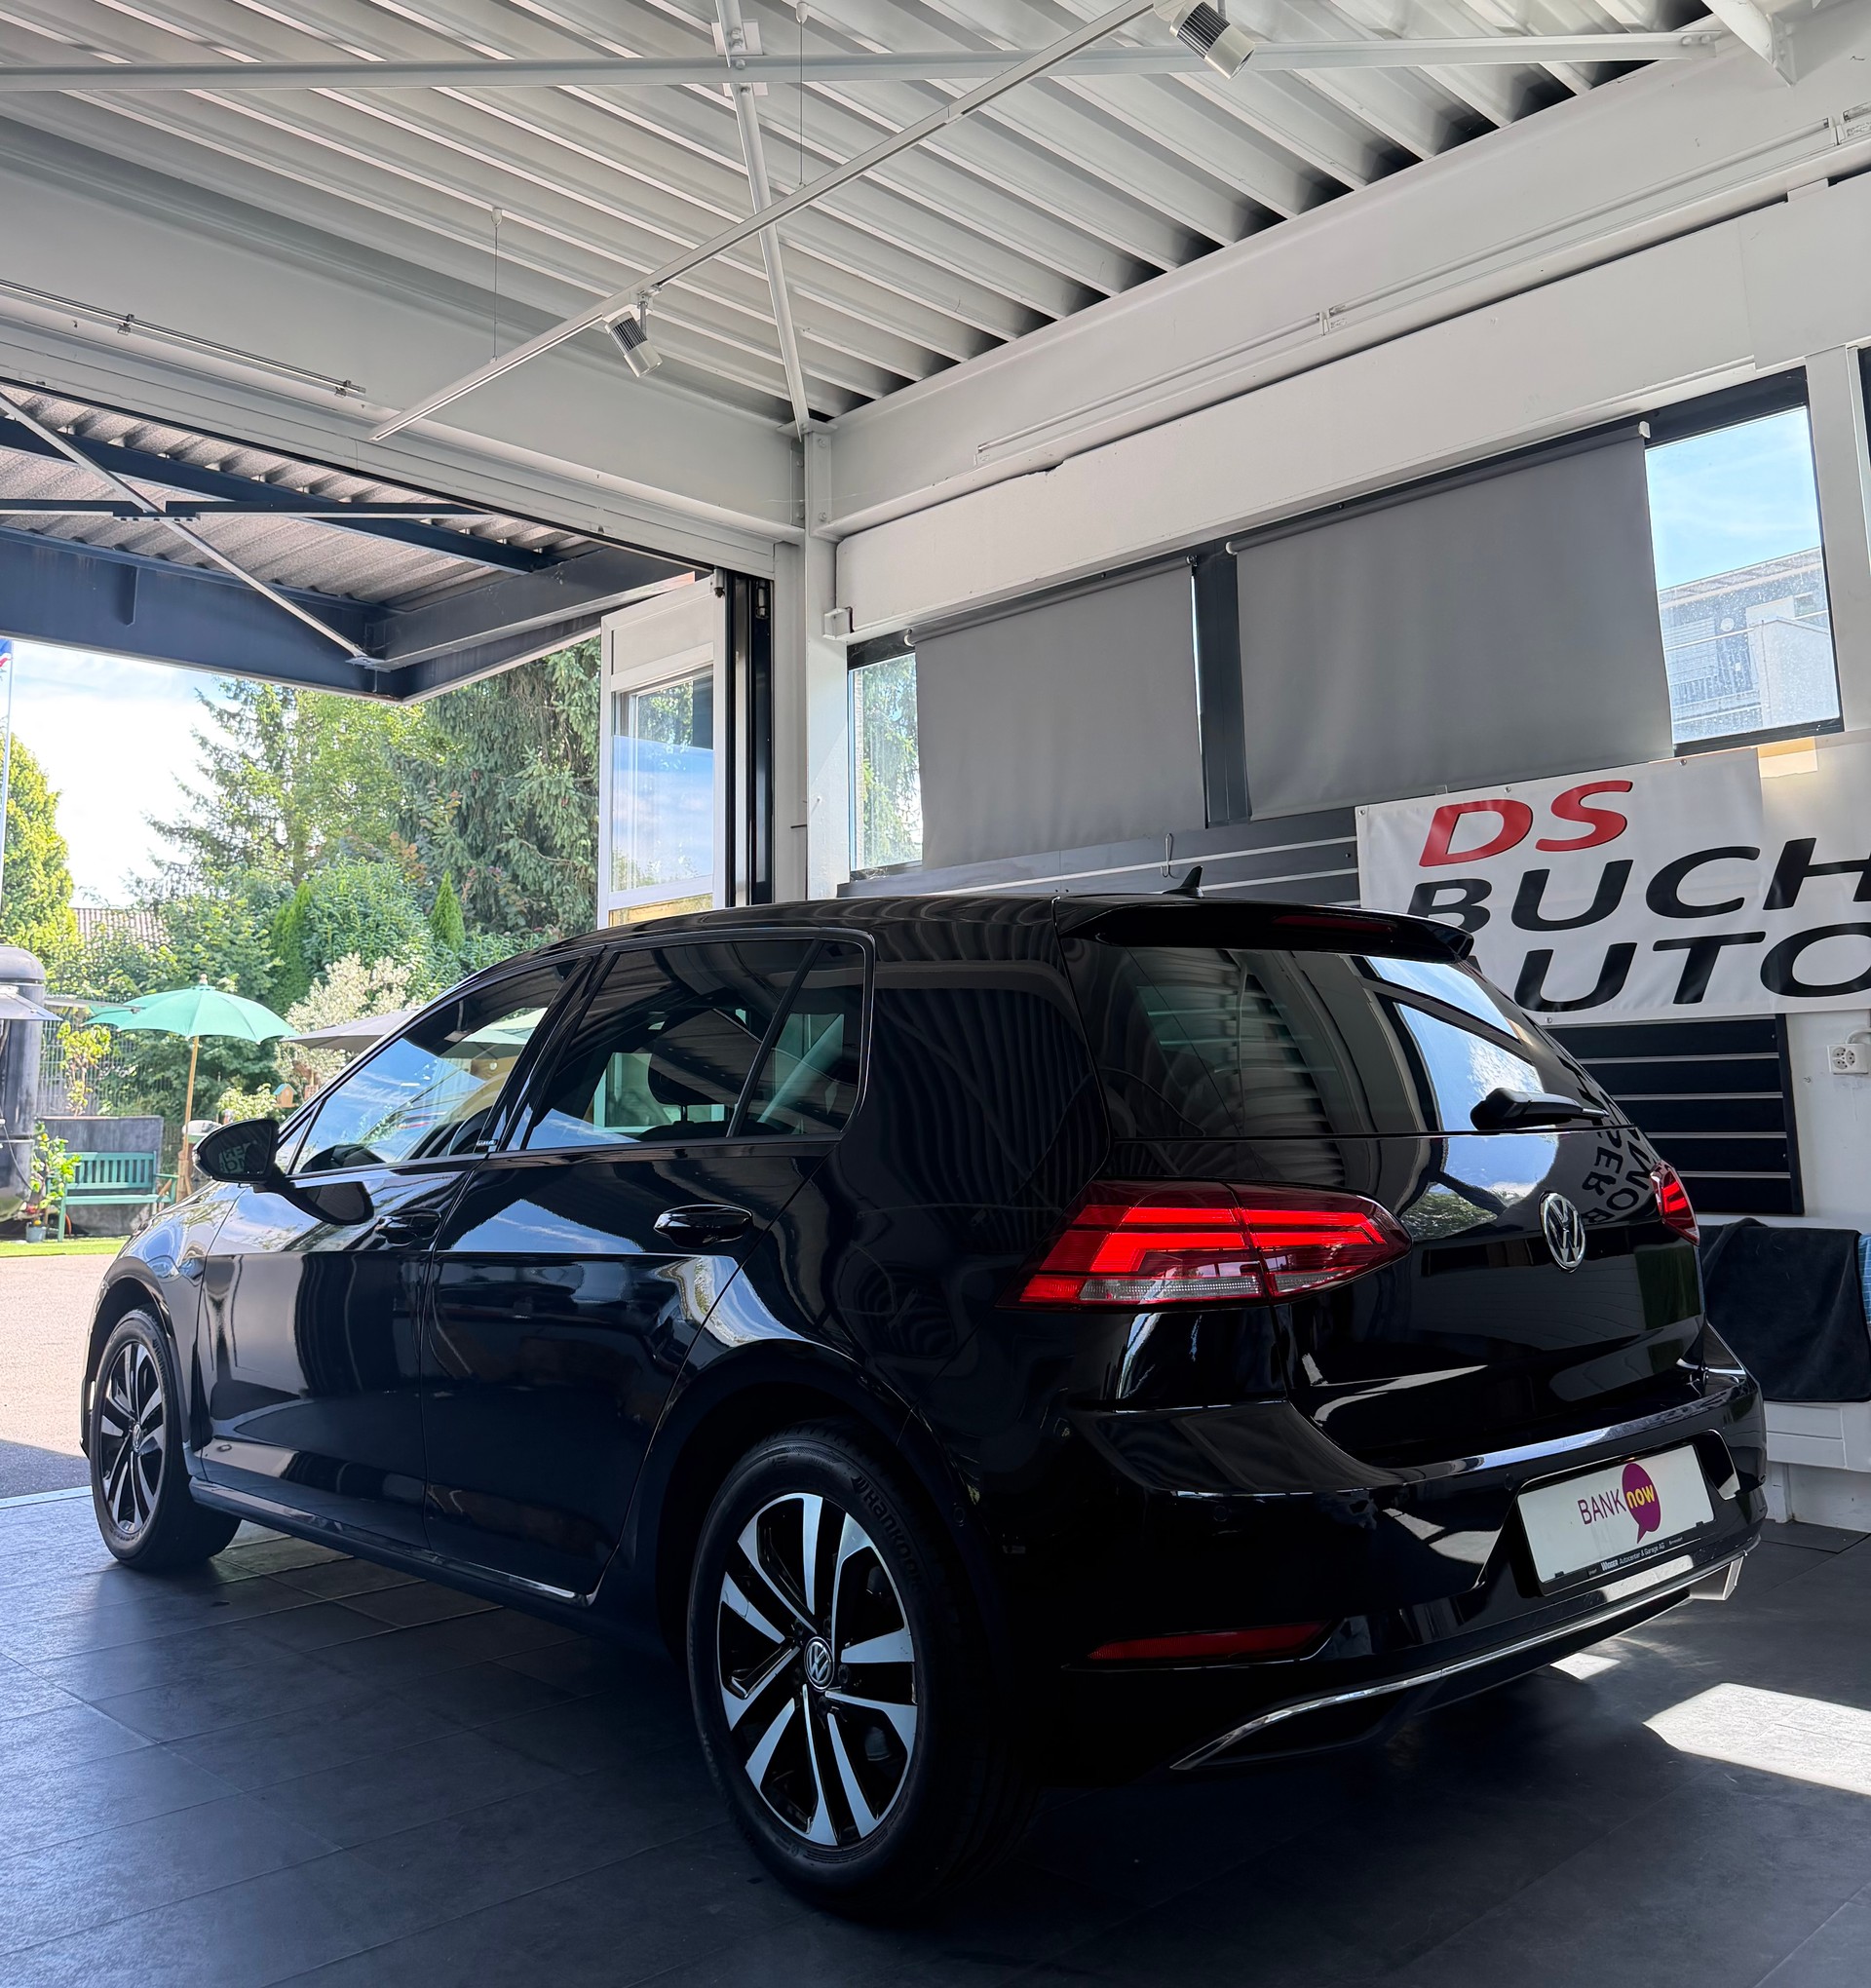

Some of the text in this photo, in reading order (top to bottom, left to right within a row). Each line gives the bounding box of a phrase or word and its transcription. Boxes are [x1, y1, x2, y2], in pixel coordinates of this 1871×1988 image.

[1419, 780, 1633, 867] DS
[1407, 837, 1871, 933] BUCH
[1468, 921, 1871, 1013] UTO
[1577, 1484, 1655, 1525] BANK now
